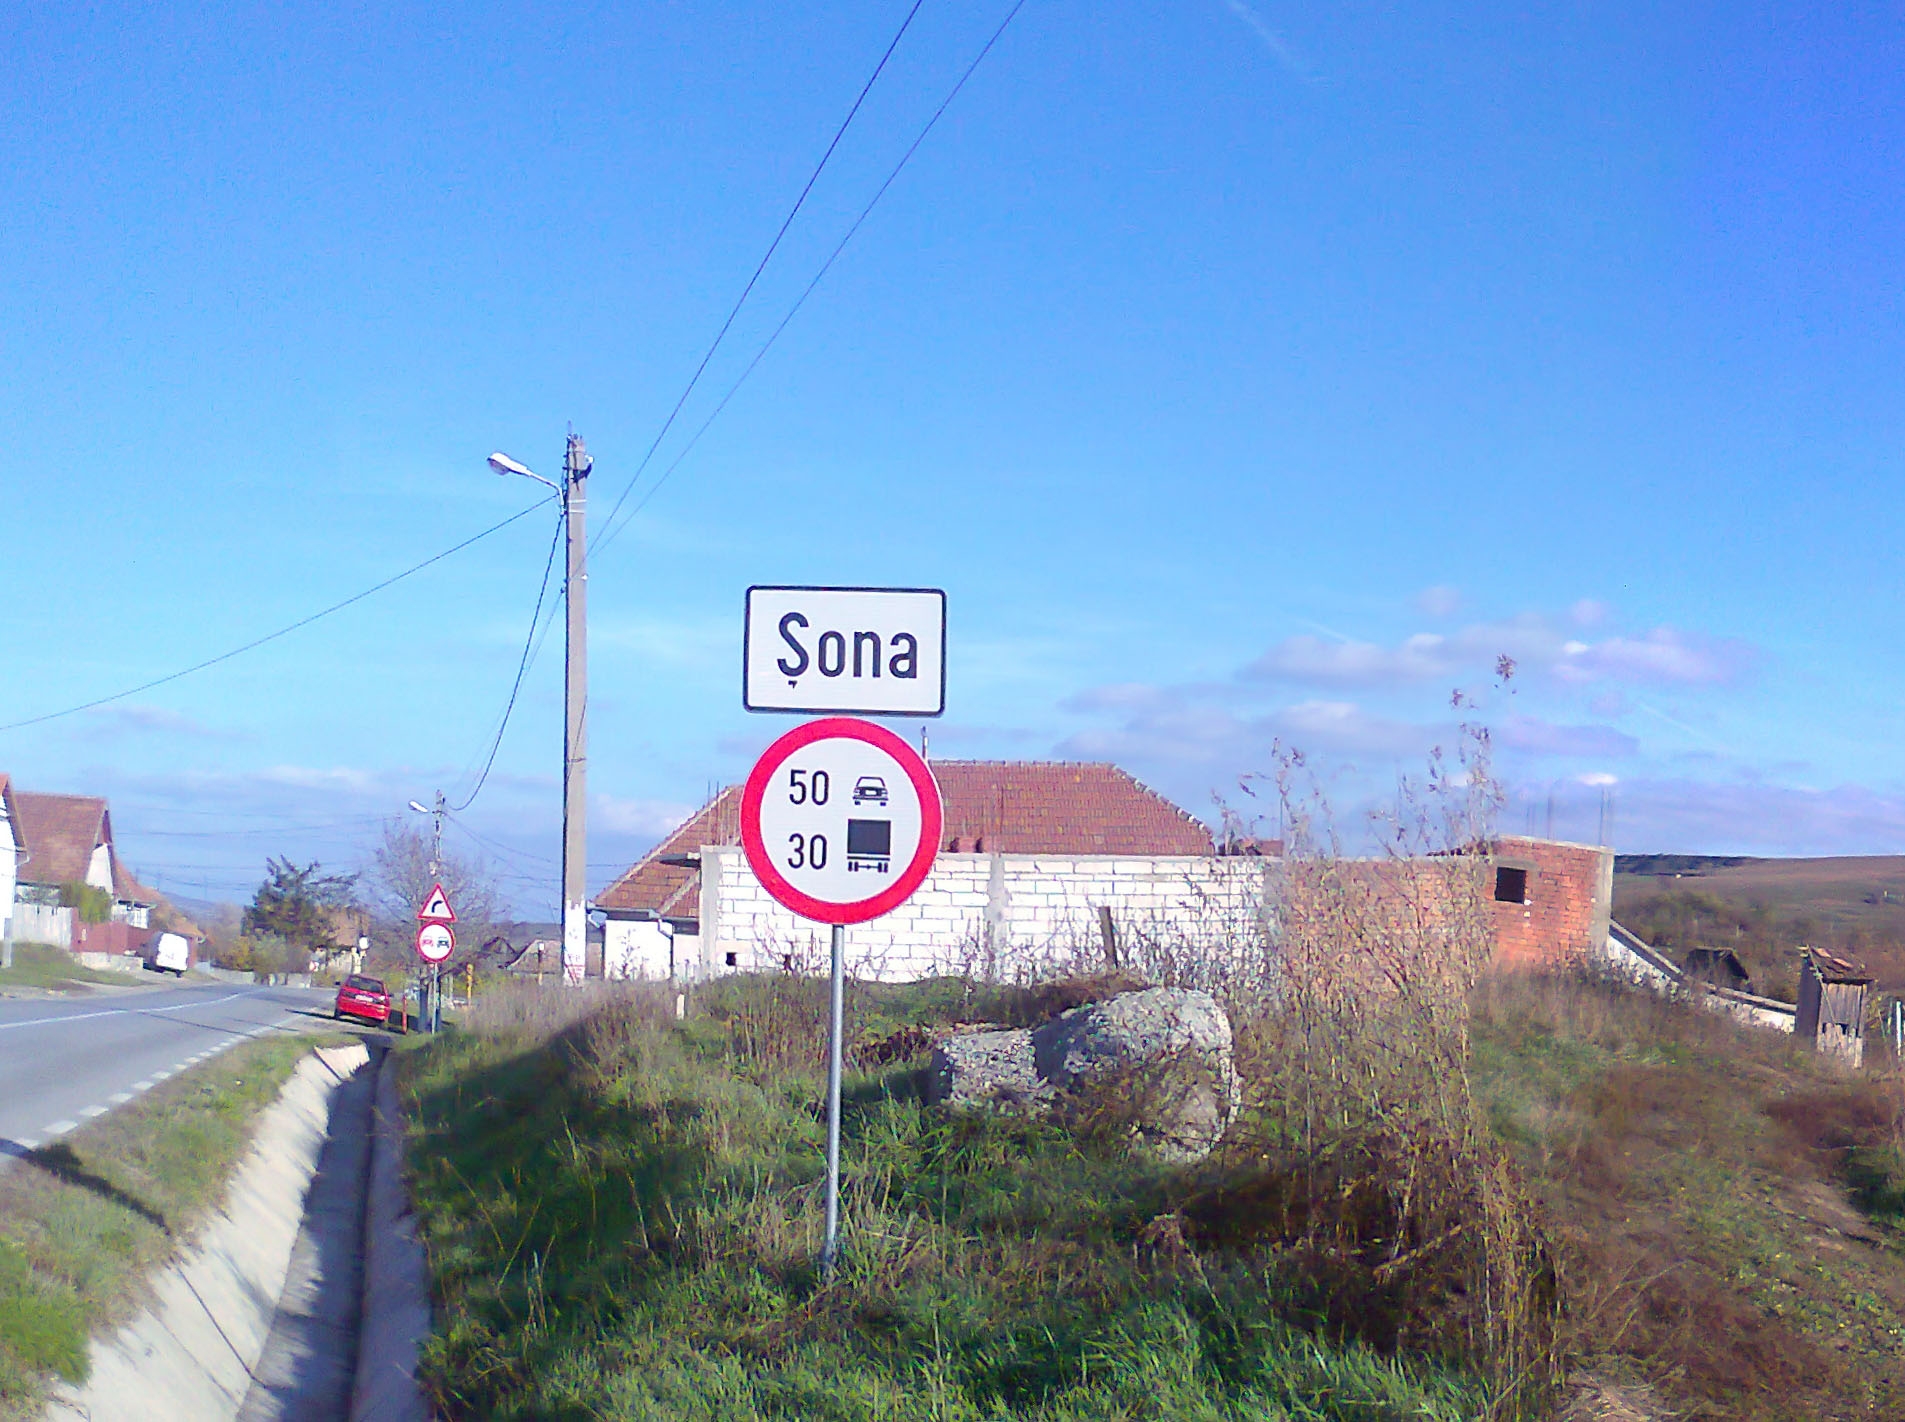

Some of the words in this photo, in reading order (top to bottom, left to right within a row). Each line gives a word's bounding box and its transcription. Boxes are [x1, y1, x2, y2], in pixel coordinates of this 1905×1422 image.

[777, 612, 917, 689] Șona
[789, 769, 829, 806] 50
[787, 833, 827, 870] 30
